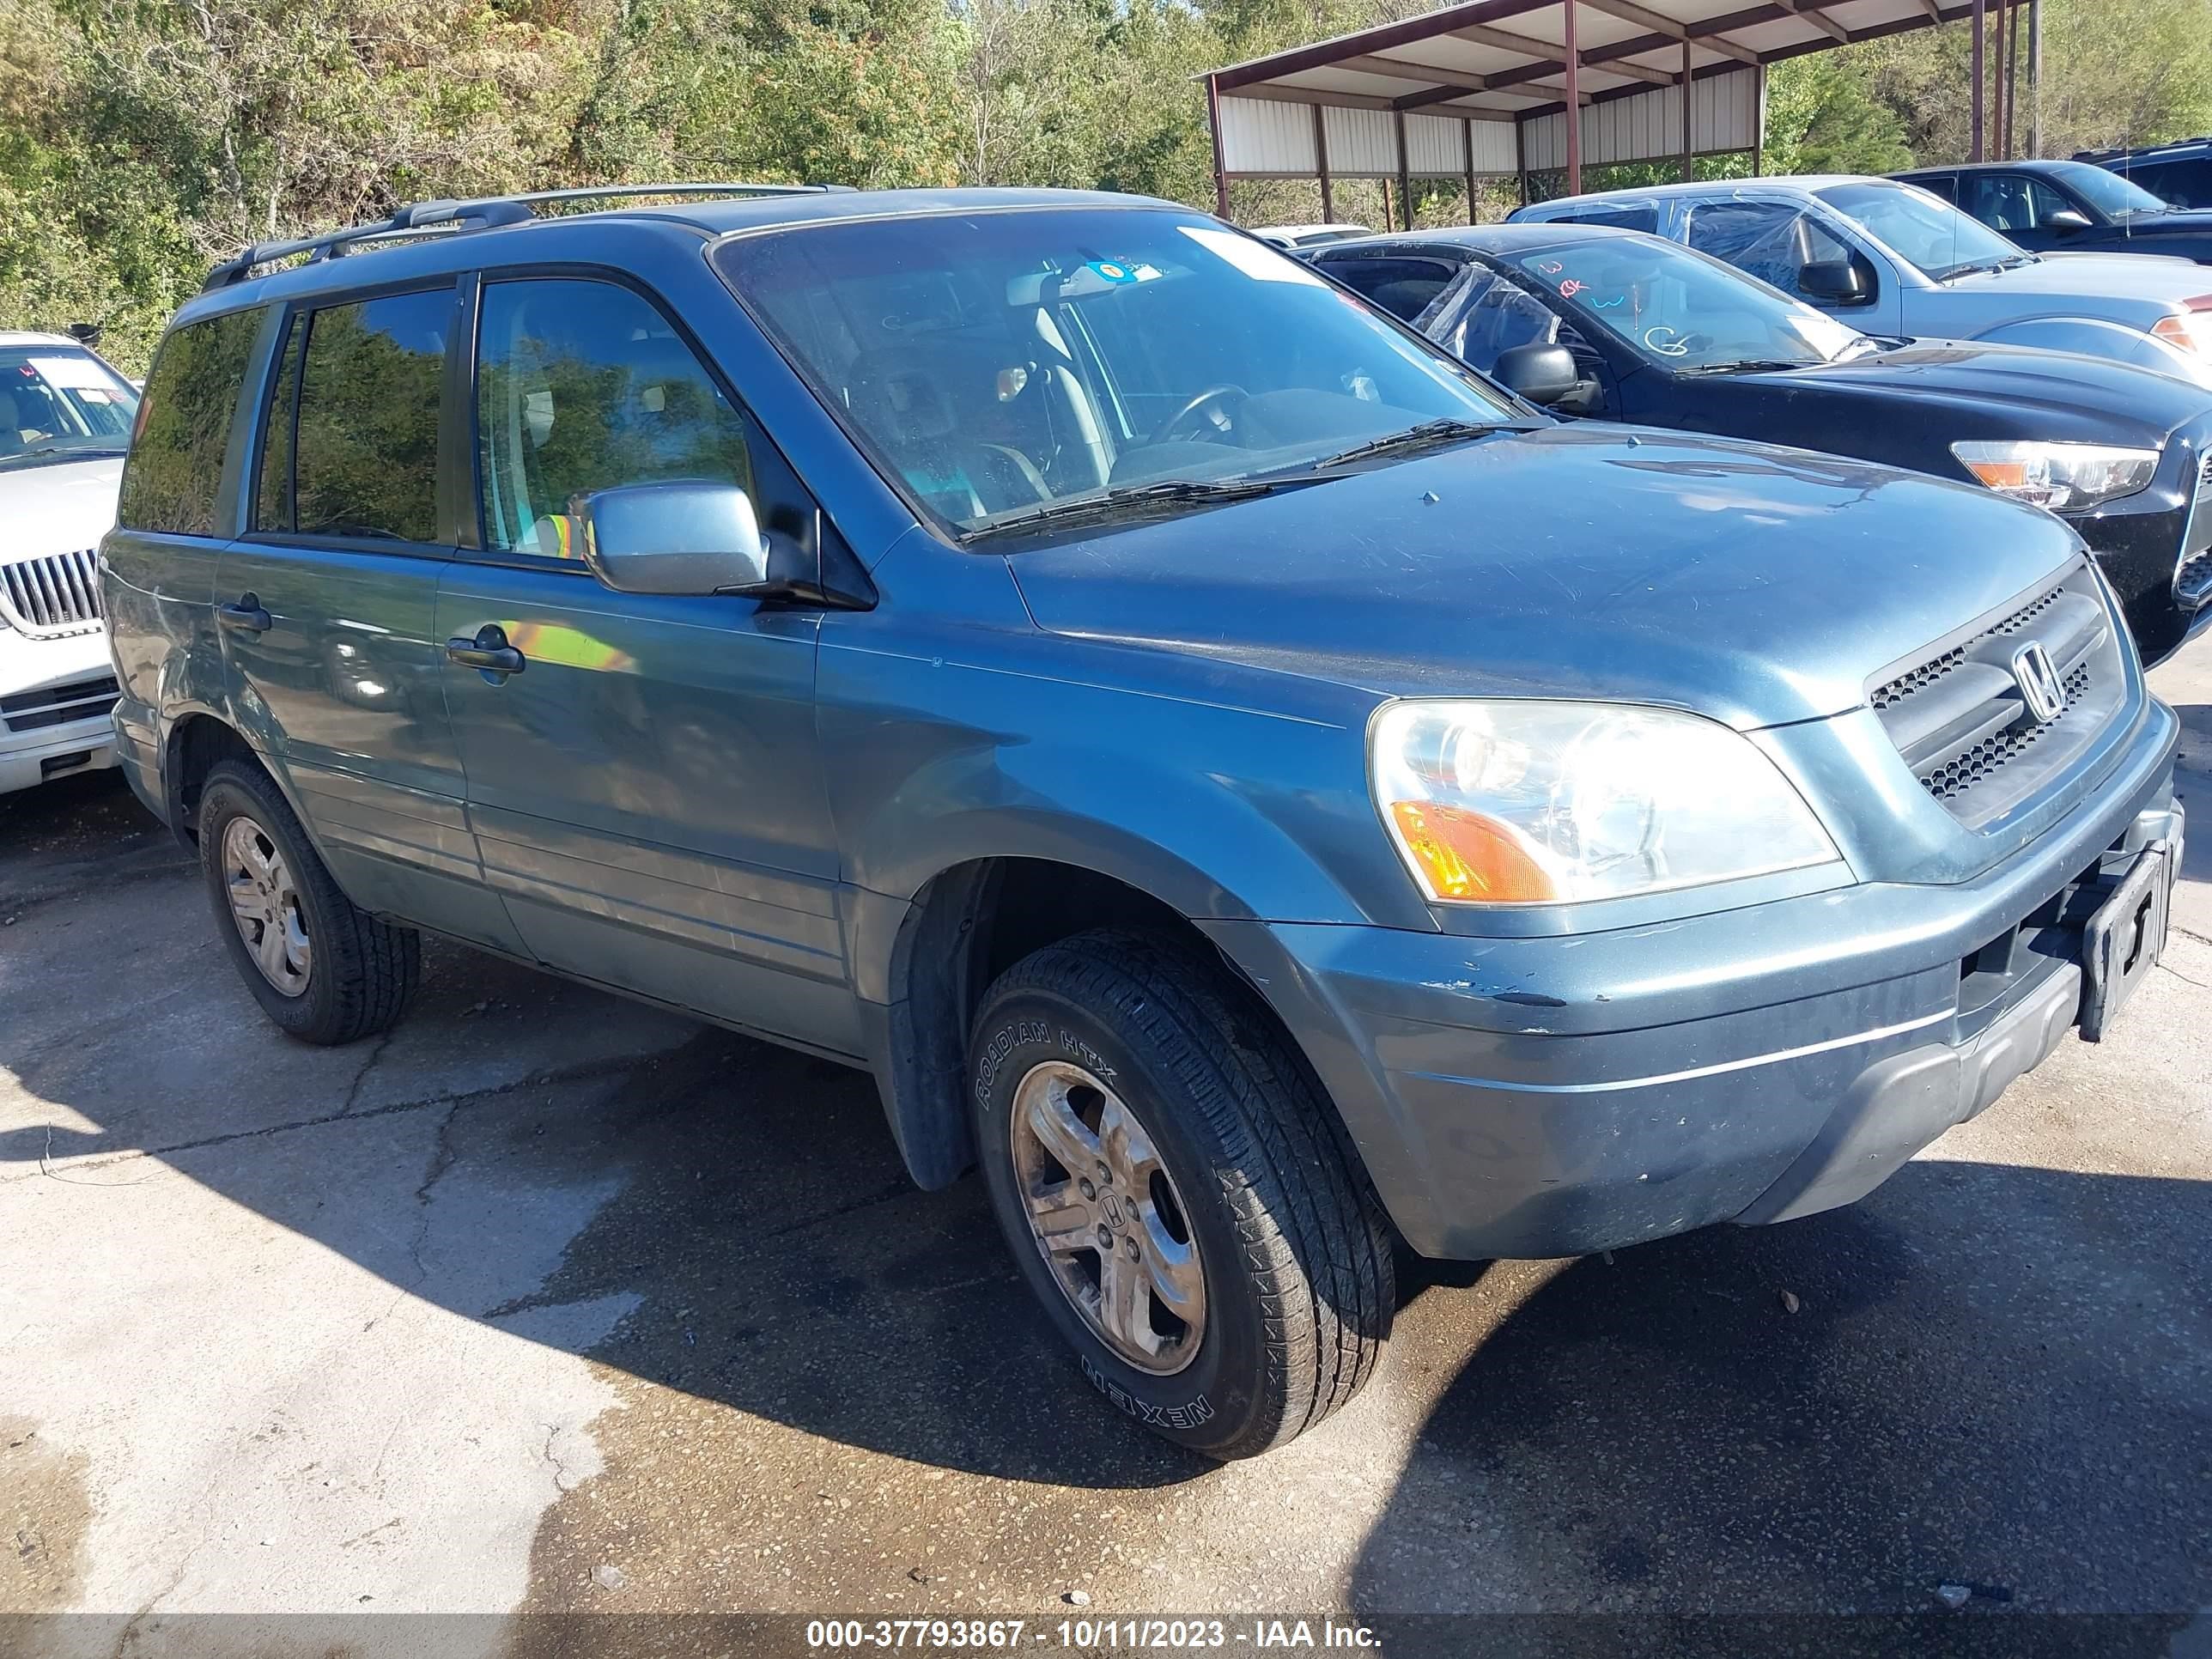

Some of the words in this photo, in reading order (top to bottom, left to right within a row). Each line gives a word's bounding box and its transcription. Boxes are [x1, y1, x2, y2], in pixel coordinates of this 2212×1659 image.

[975, 1023, 1051, 1111] ROADIAN
[1060, 1030, 1117, 1087] HTX
[1081, 1354, 1215, 1429] NEXEN
